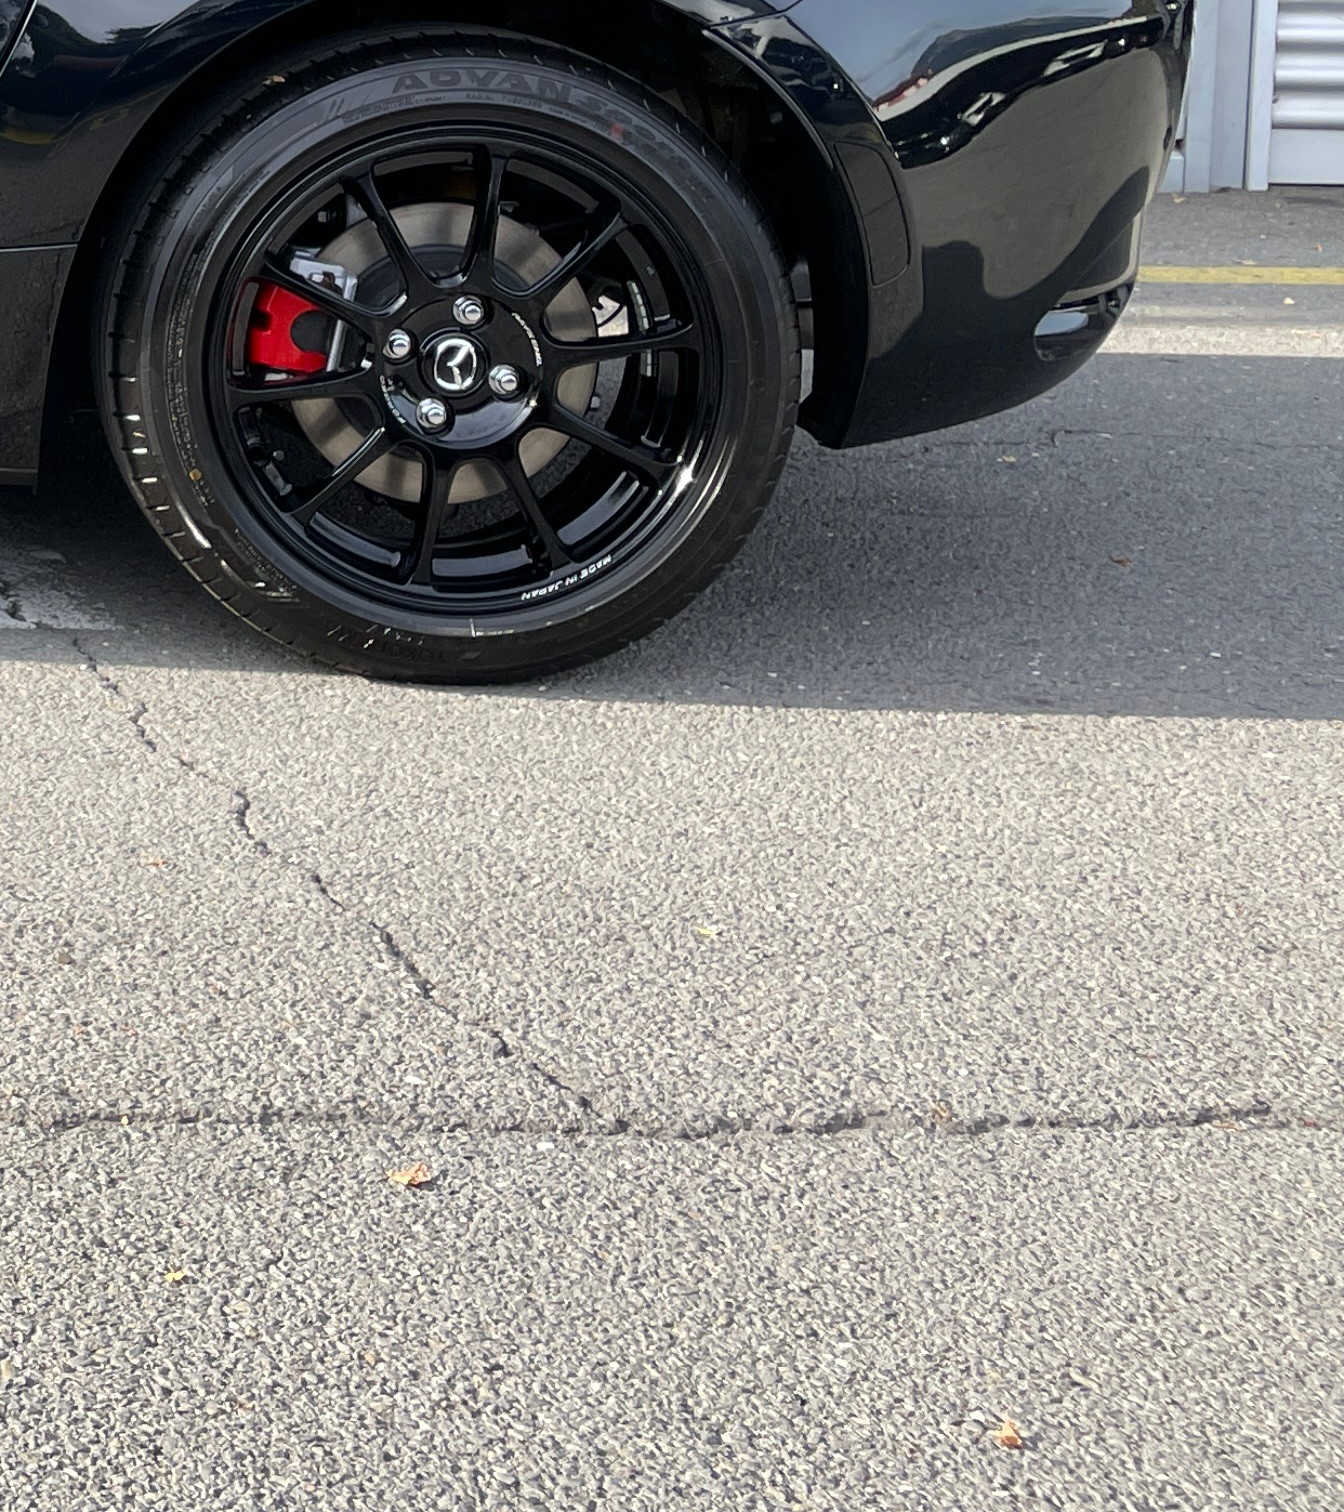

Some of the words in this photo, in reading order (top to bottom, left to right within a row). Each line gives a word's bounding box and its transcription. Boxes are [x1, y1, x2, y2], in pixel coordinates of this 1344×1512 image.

[391, 69, 574, 105] ADVAN
[579, 554, 612, 579] MADE
[521, 580, 564, 601] JAPAN
[564, 574, 578, 586] IN
